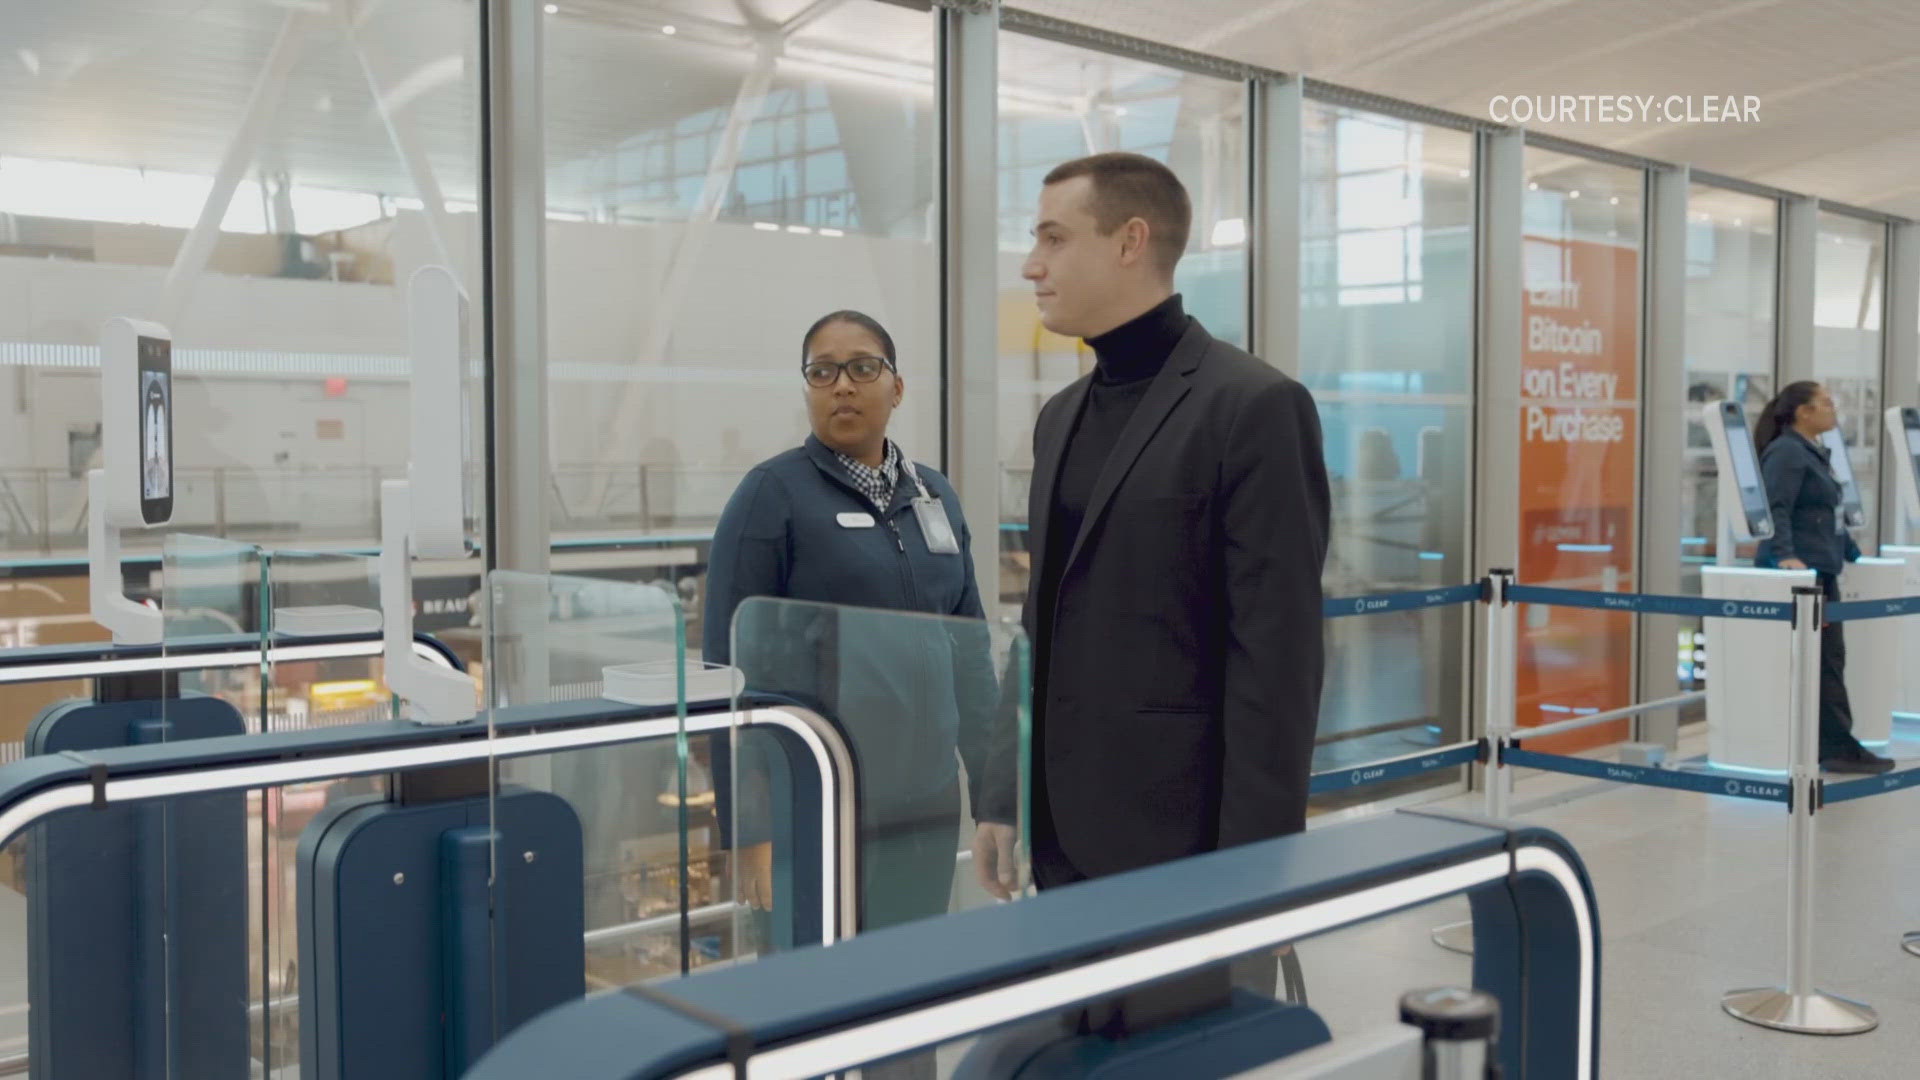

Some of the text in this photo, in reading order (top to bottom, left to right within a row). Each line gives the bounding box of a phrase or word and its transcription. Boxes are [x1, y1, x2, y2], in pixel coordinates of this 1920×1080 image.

[1529, 315, 1603, 354] Bitcoin
[1525, 362, 1619, 401] on Every
[1526, 406, 1624, 442] Purchase
[1742, 606, 1779, 615] CLEAR
[1744, 785, 1782, 797] CLEAR
